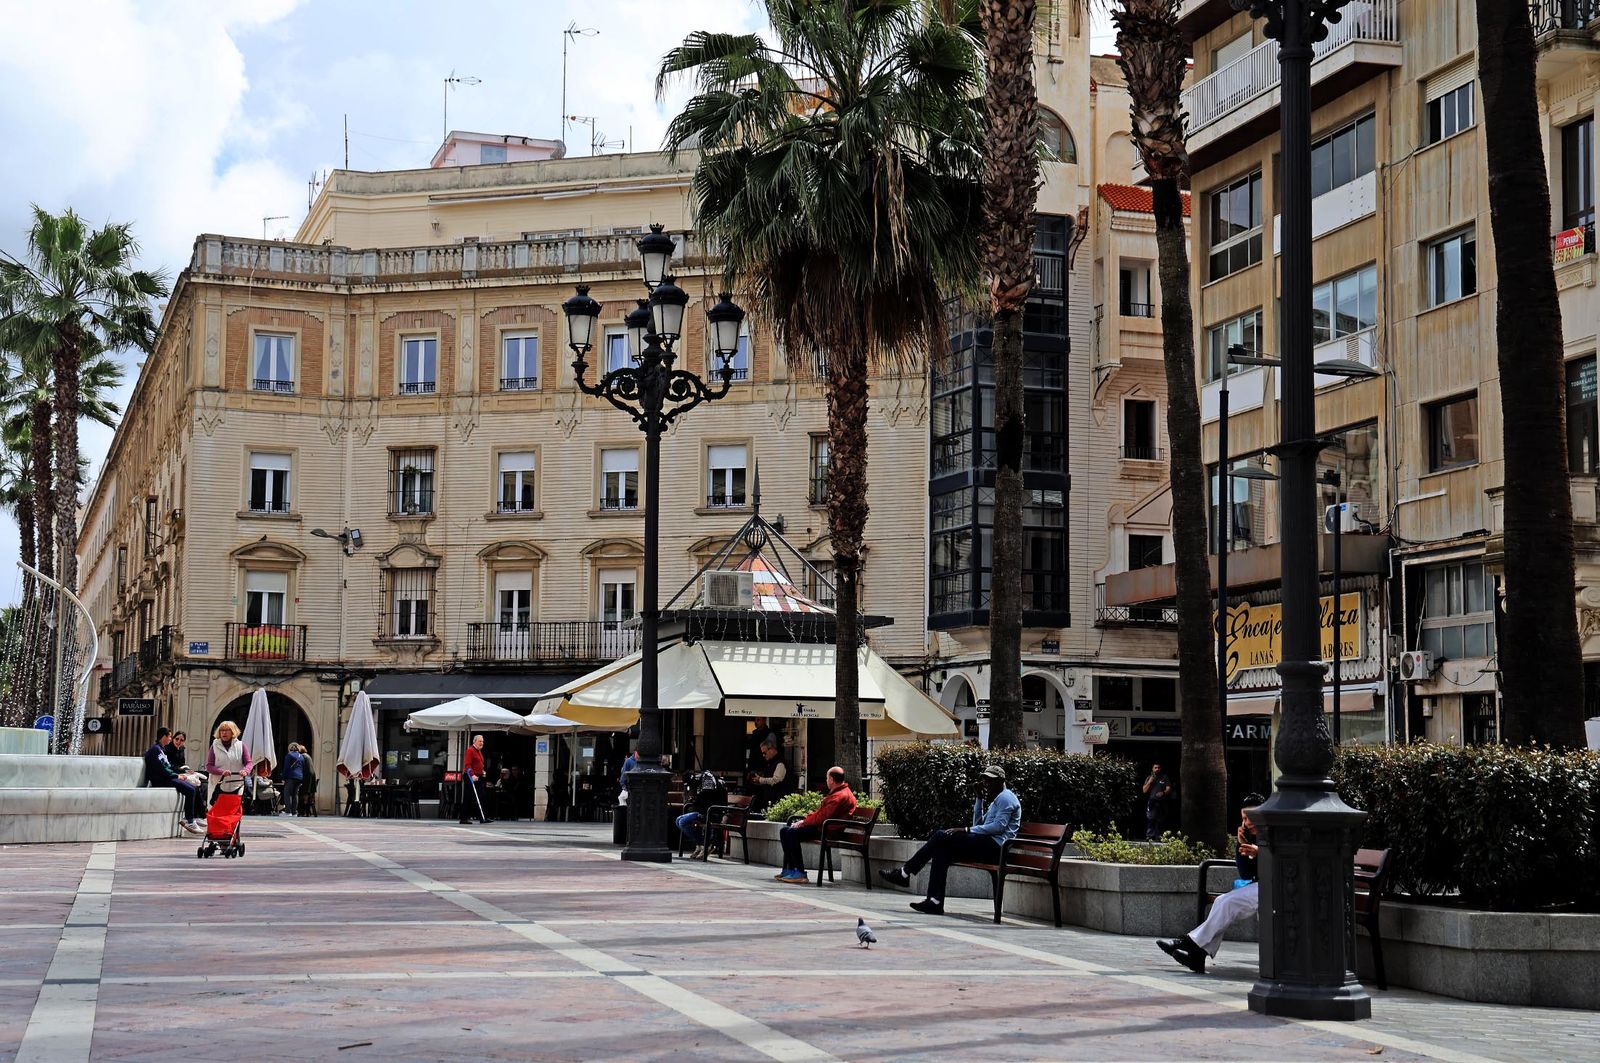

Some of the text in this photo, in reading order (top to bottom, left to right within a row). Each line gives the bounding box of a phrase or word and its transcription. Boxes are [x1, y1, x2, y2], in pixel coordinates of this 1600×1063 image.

[1320, 600, 1359, 628] laza
[1250, 650, 1274, 666] LANAS
[1323, 641, 1354, 659] ABRES
